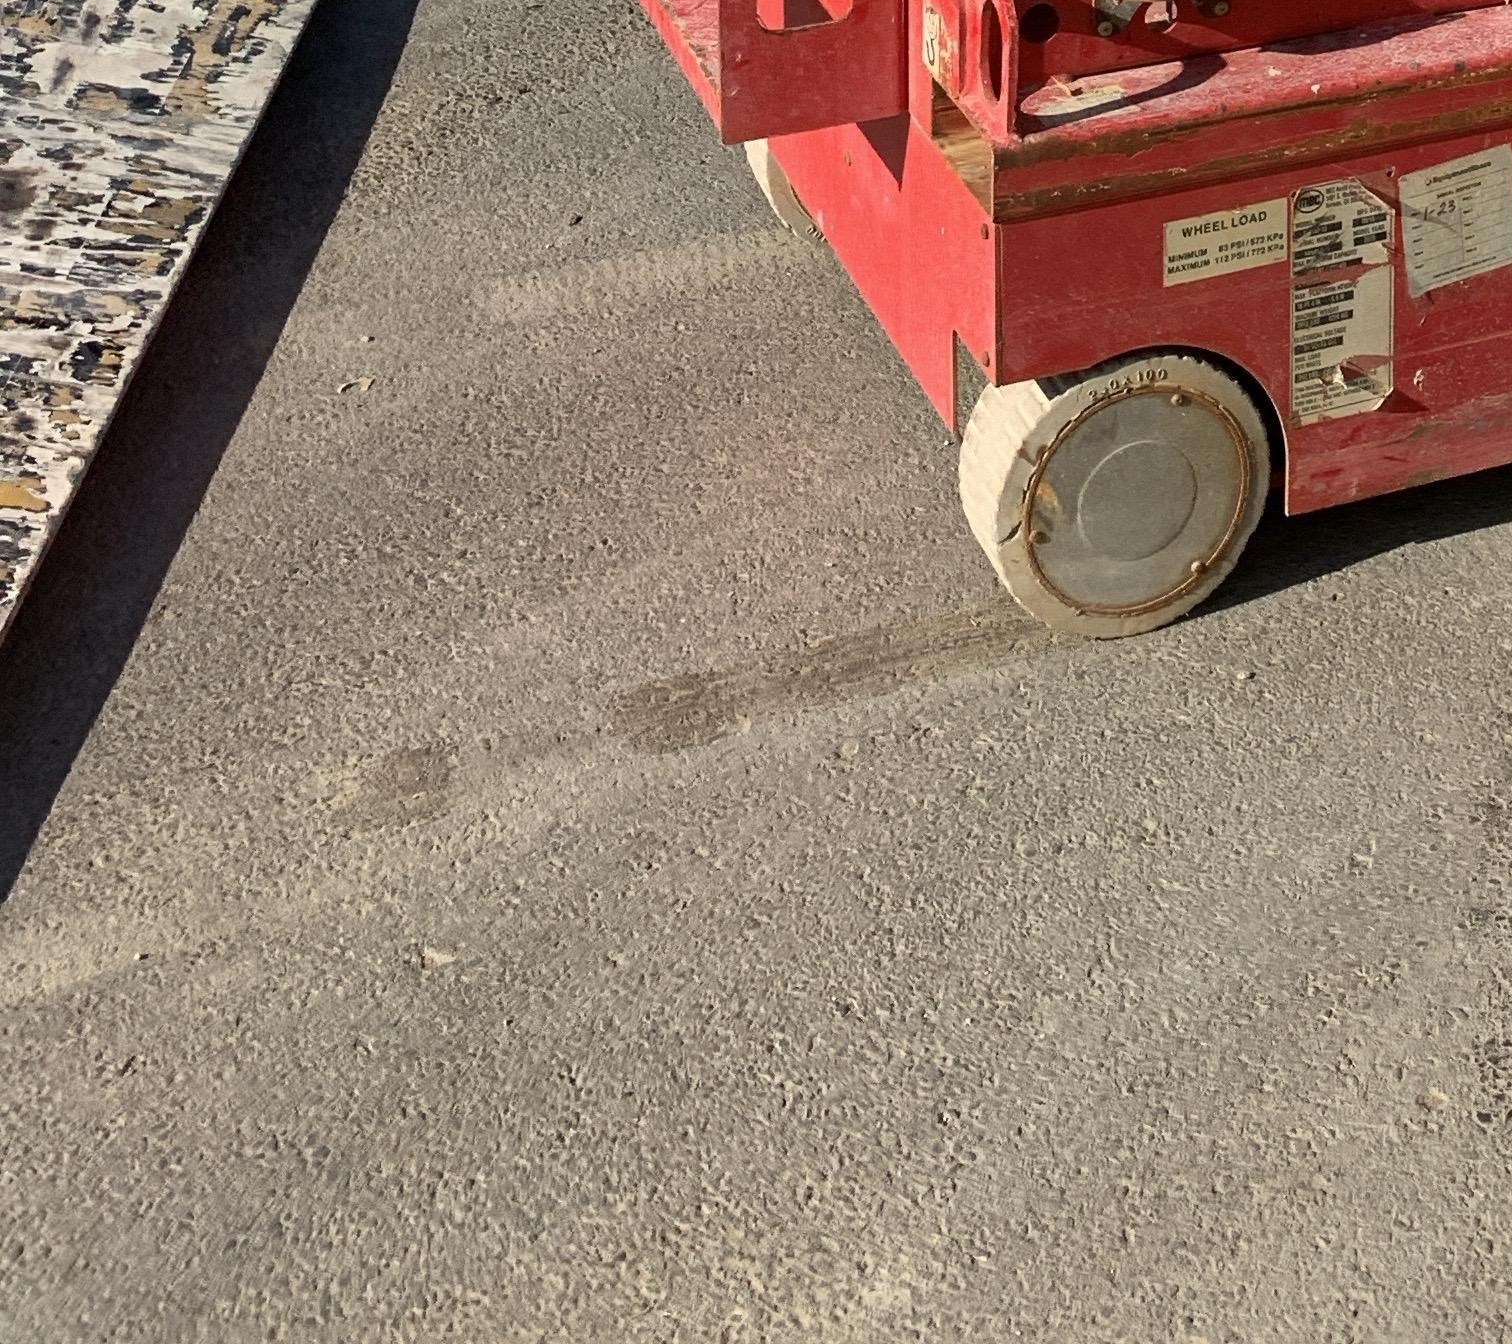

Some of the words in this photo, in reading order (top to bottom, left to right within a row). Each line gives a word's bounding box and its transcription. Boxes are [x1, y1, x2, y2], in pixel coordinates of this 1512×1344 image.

[1181, 219, 1228, 238] WHEEL
[1231, 211, 1267, 228] LOAD
[1168, 248, 1208, 264] MINIMUM
[1167, 260, 1211, 274] MAXIMUM
